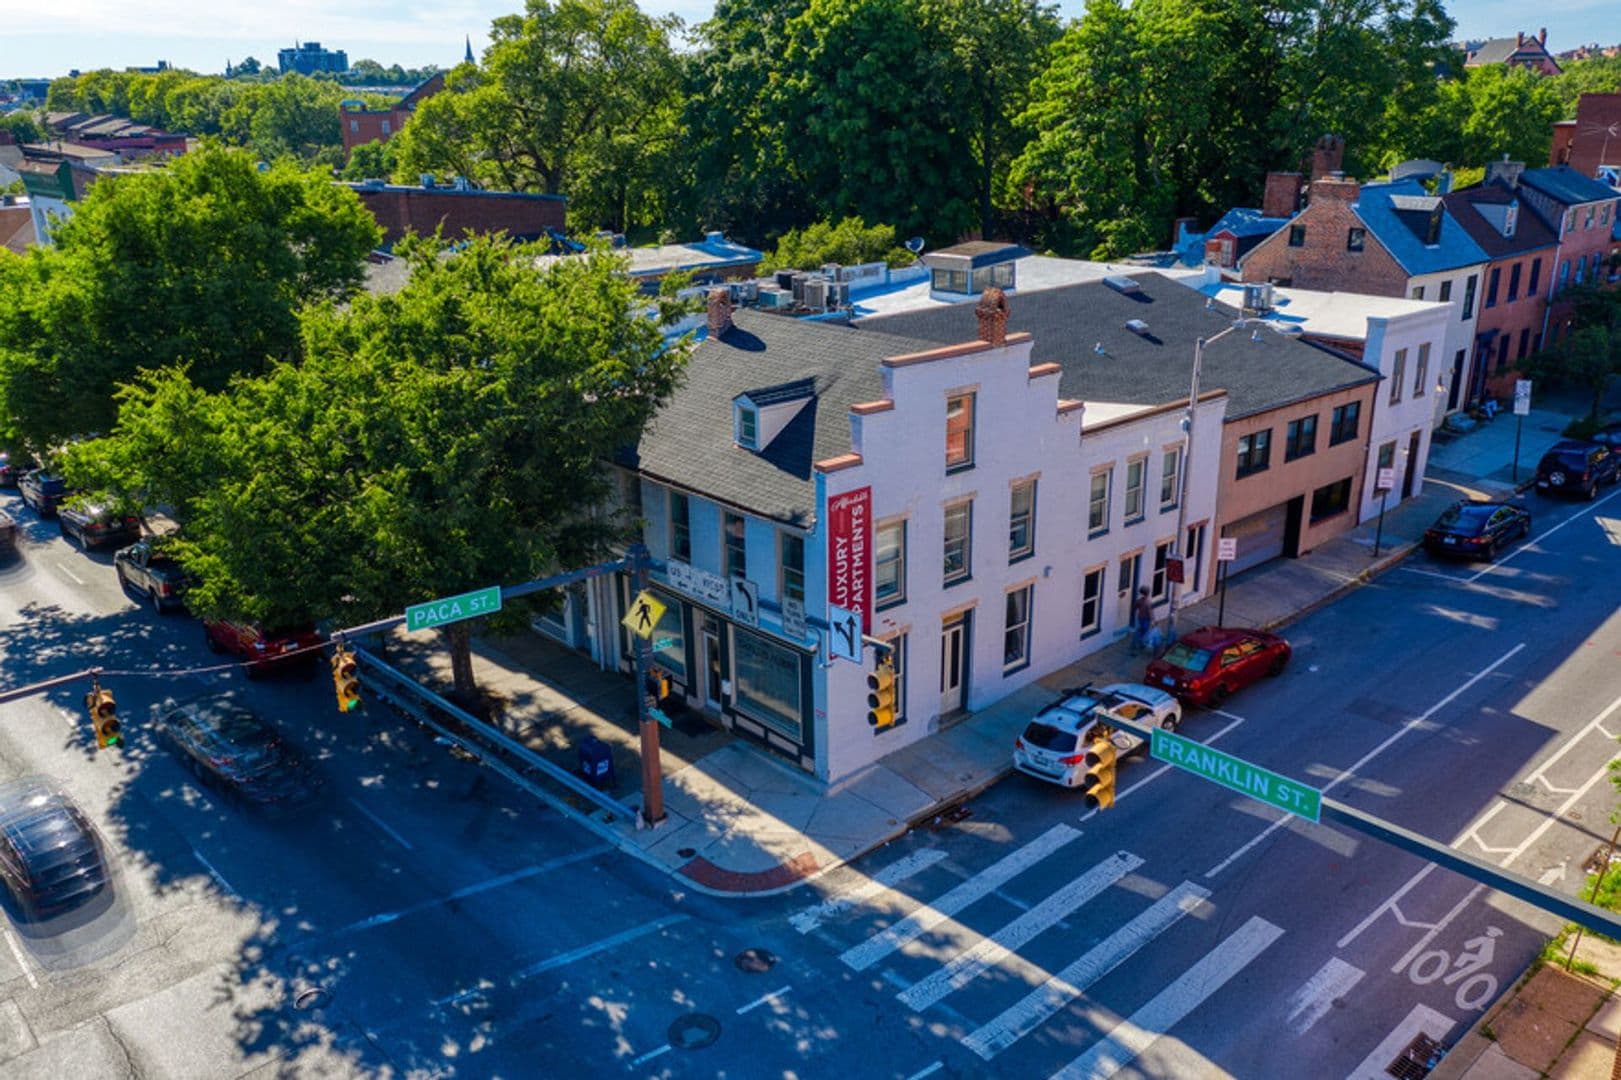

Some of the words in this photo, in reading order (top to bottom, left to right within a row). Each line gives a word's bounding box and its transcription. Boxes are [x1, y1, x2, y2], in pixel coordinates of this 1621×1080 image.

[836, 536, 848, 608] LUXURY
[851, 504, 864, 617] PARTMENTS
[413, 602, 463, 625] PACA
[469, 595, 495, 611] ST.
[1158, 736, 1270, 797] FRANKLIN
[1277, 783, 1310, 811] ST.
